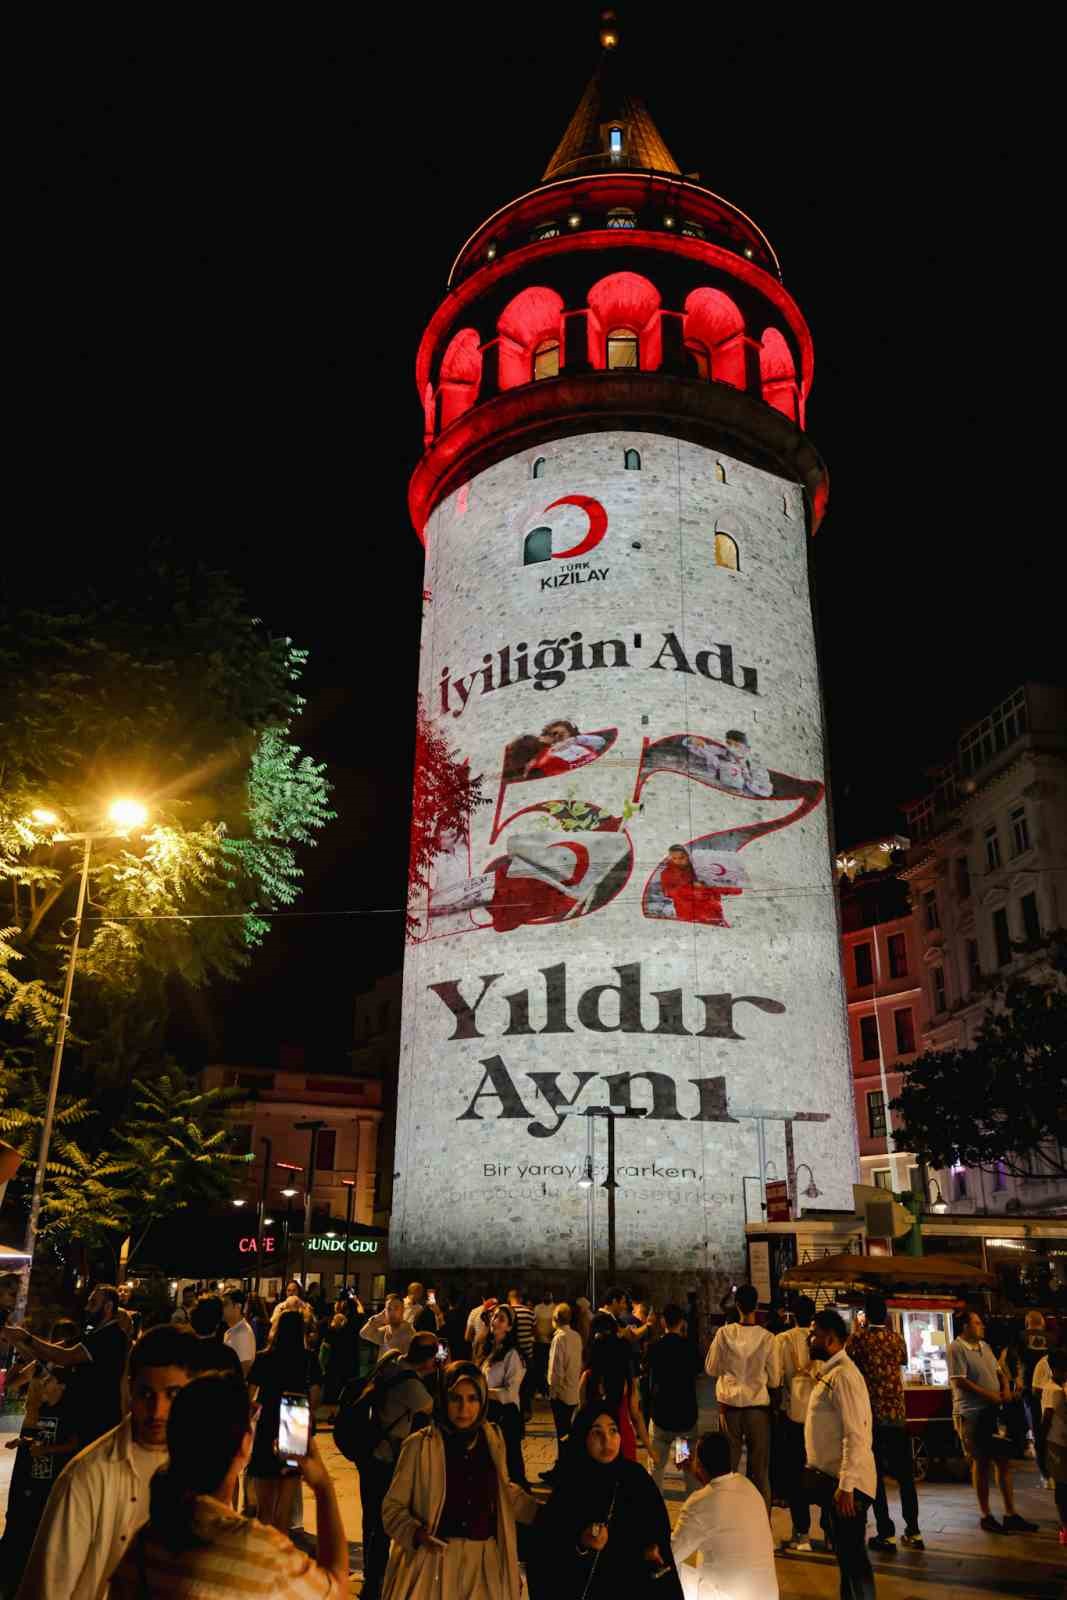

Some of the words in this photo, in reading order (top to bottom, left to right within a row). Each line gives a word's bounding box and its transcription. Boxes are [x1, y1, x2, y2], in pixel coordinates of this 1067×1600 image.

[540, 567, 610, 590] KIZILAY
[650, 632, 761, 696] Adı
[427, 961, 786, 1041] Yıldır
[455, 1054, 740, 1138] Aynı
[483, 1162, 512, 1177] Bir
